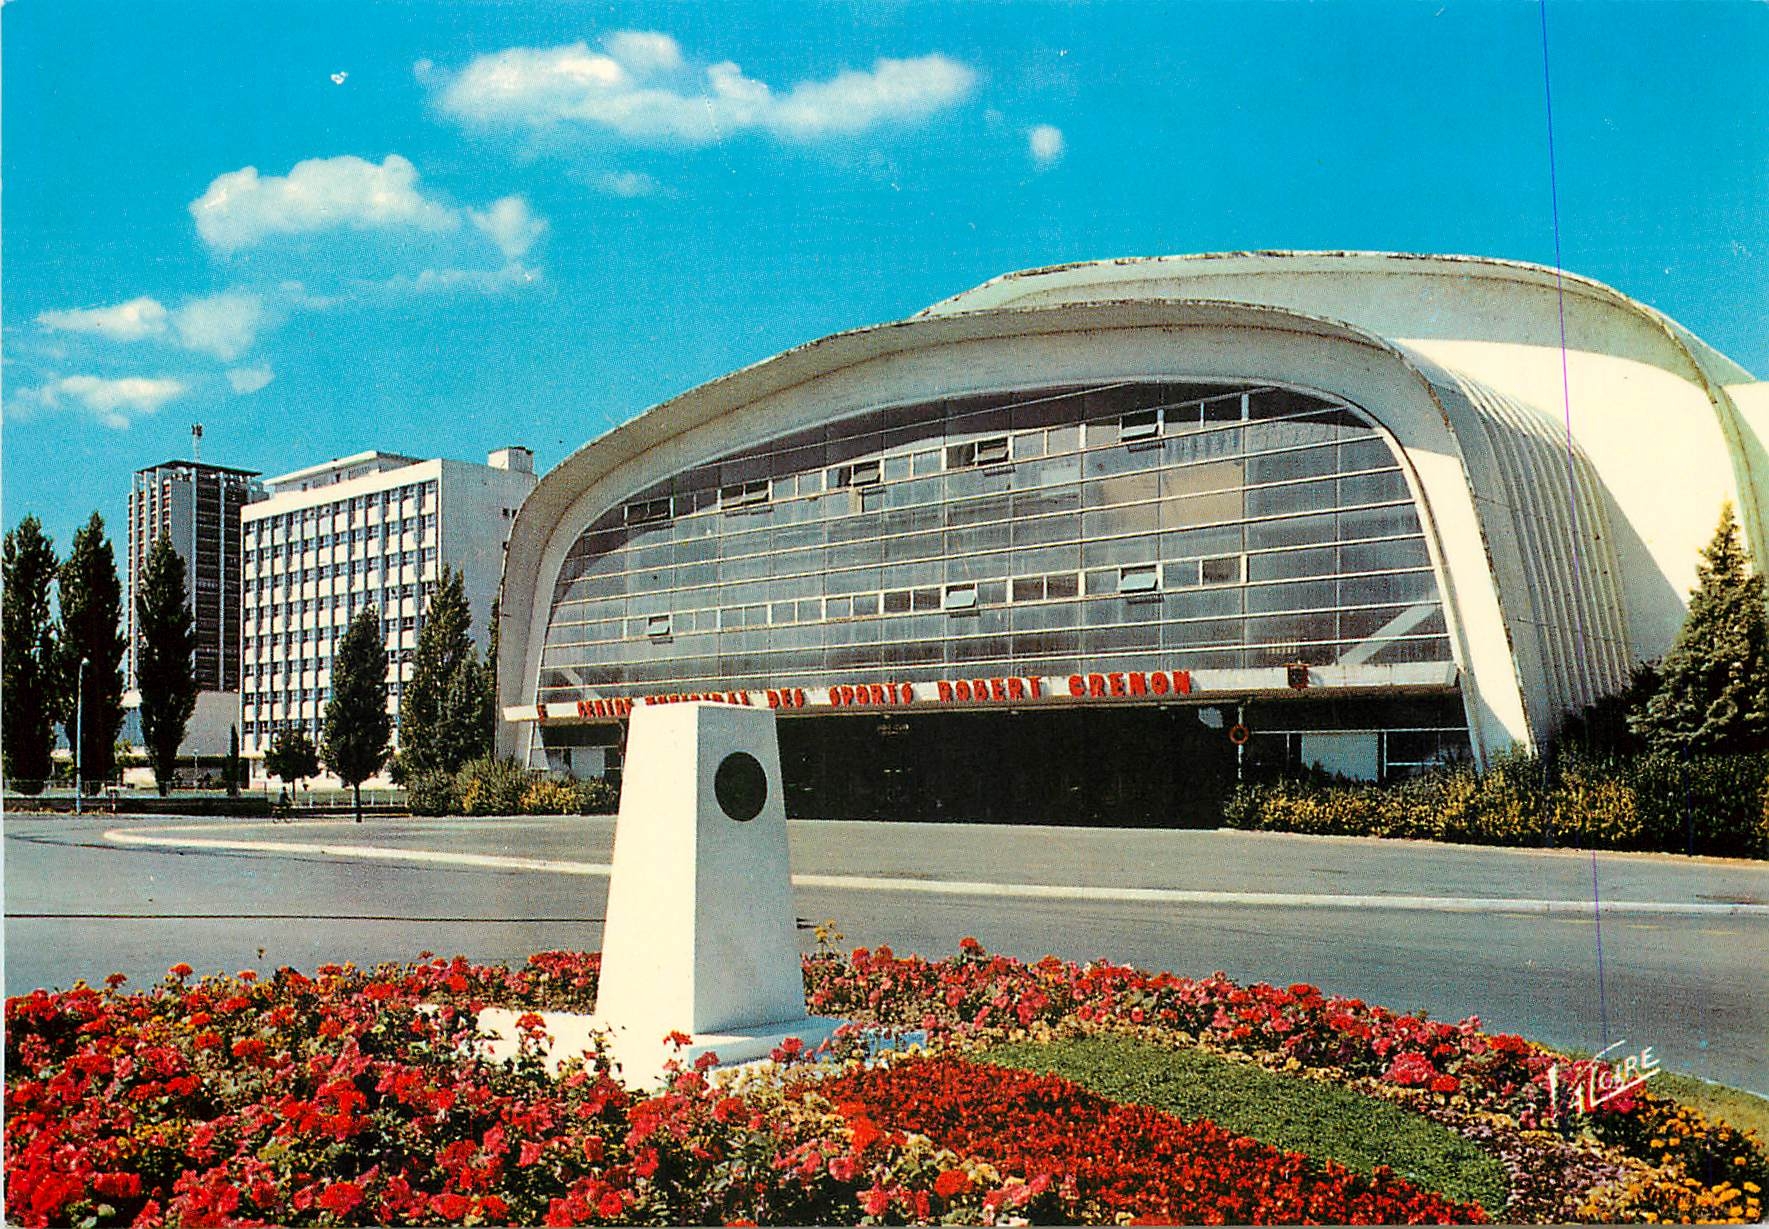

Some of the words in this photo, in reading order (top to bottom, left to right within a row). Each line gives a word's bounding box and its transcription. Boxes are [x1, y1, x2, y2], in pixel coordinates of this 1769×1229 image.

[766, 687, 804, 710] DES
[829, 682, 913, 709] SPORTS
[937, 675, 1043, 705] ROBERT
[1068, 669, 1192, 700] GRENON
